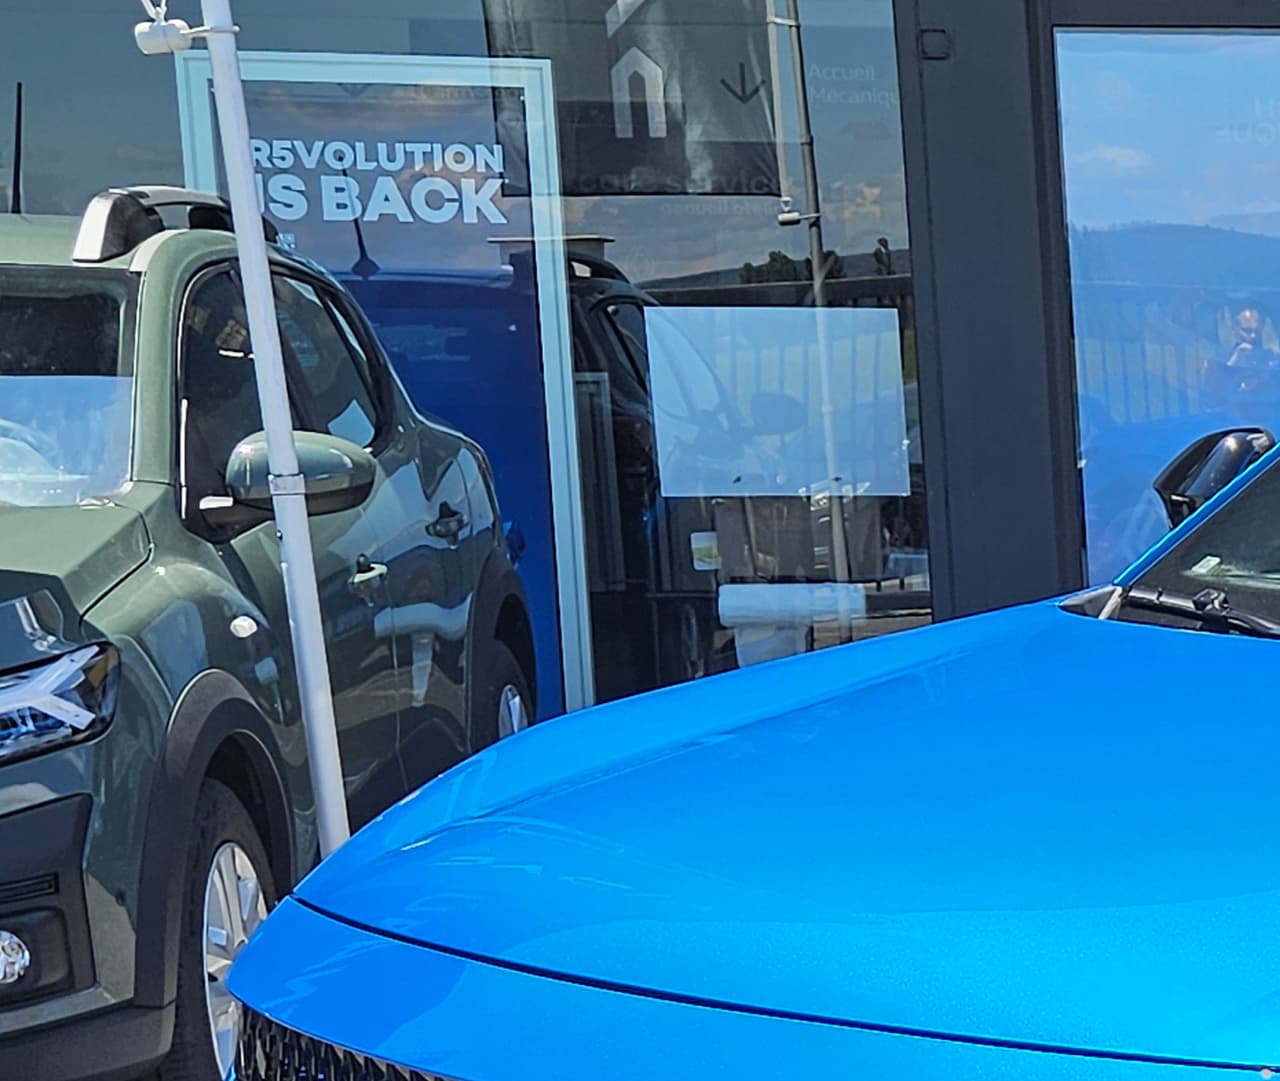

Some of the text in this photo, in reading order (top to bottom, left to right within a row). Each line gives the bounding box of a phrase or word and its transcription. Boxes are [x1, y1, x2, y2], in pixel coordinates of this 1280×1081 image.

[808, 64, 875, 80] Accueil
[250, 138, 504, 173] R5VOLUTION
[320, 175, 508, 224] BACK
